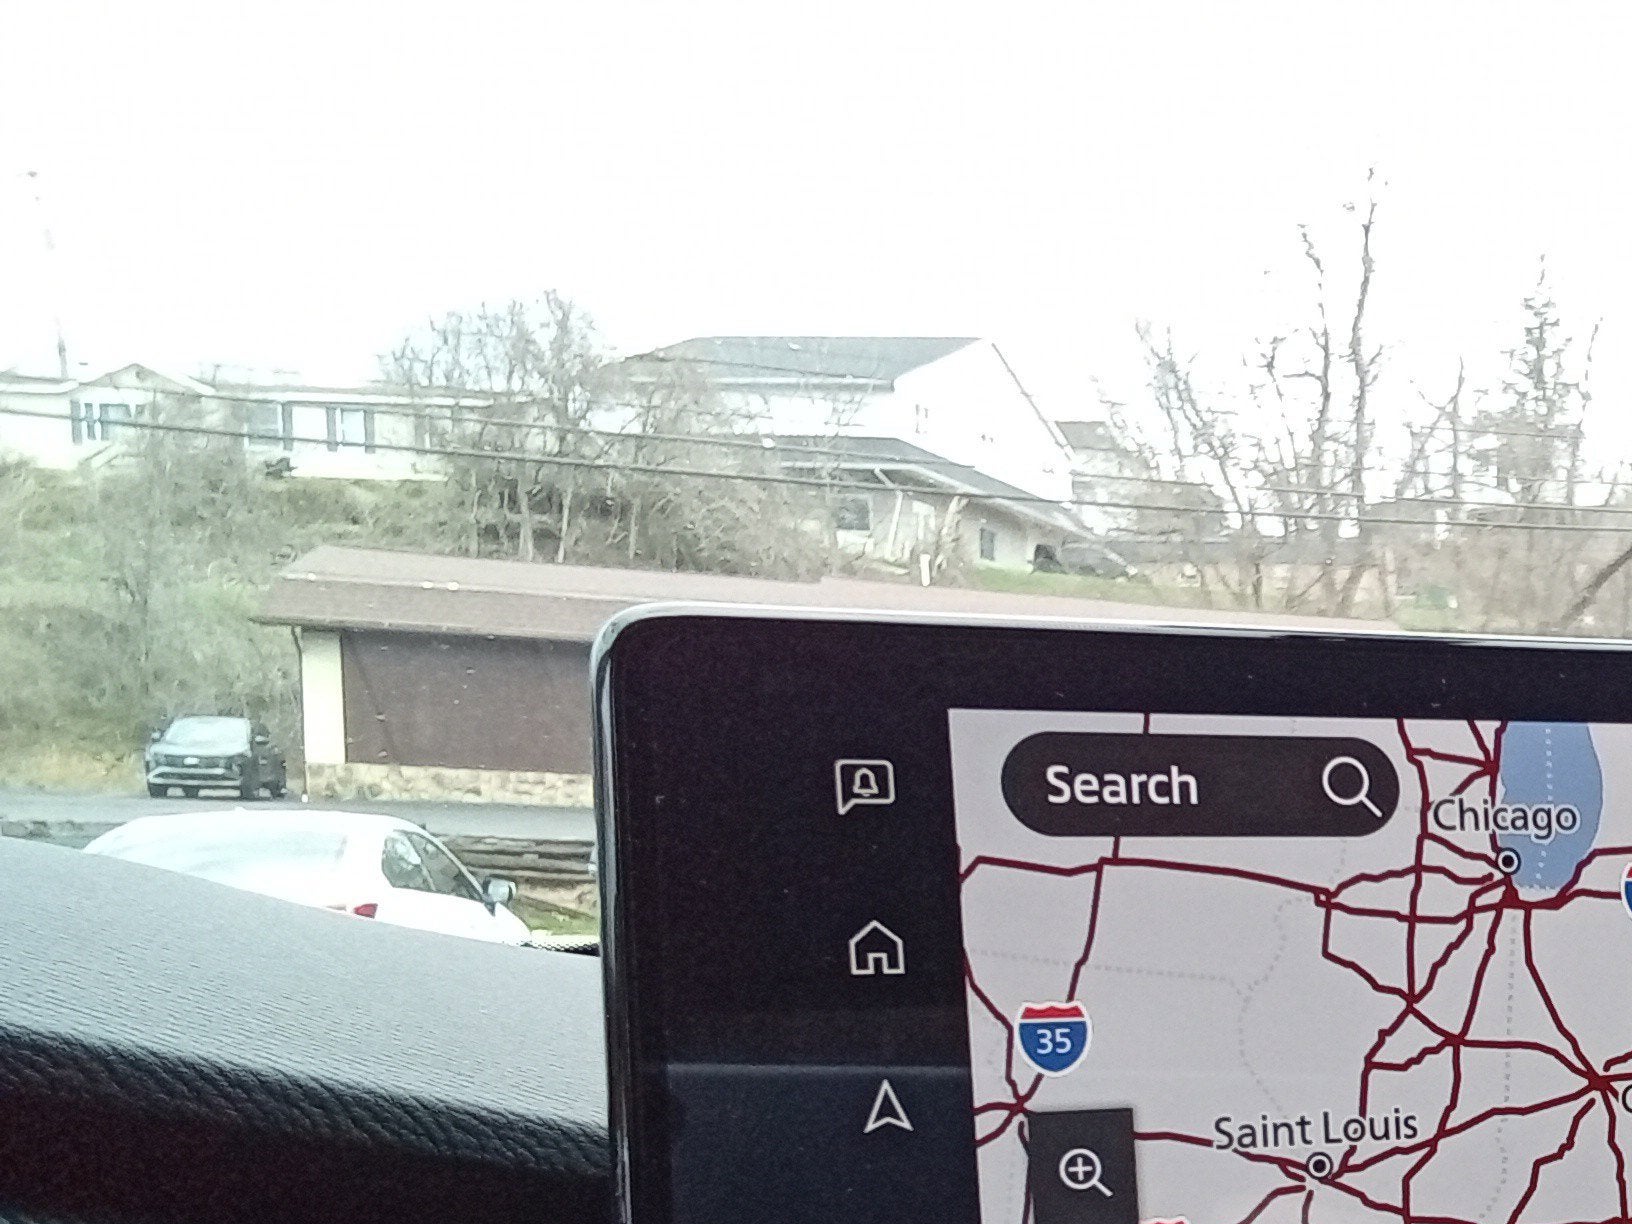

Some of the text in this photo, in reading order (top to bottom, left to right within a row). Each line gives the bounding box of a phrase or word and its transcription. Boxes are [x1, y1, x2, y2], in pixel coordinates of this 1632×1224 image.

[1046, 765, 1199, 805] Search
[1433, 800, 1578, 838] Chicago
[1036, 1029, 1073, 1054] 35
[1213, 1109, 1419, 1149] Saint Louis
